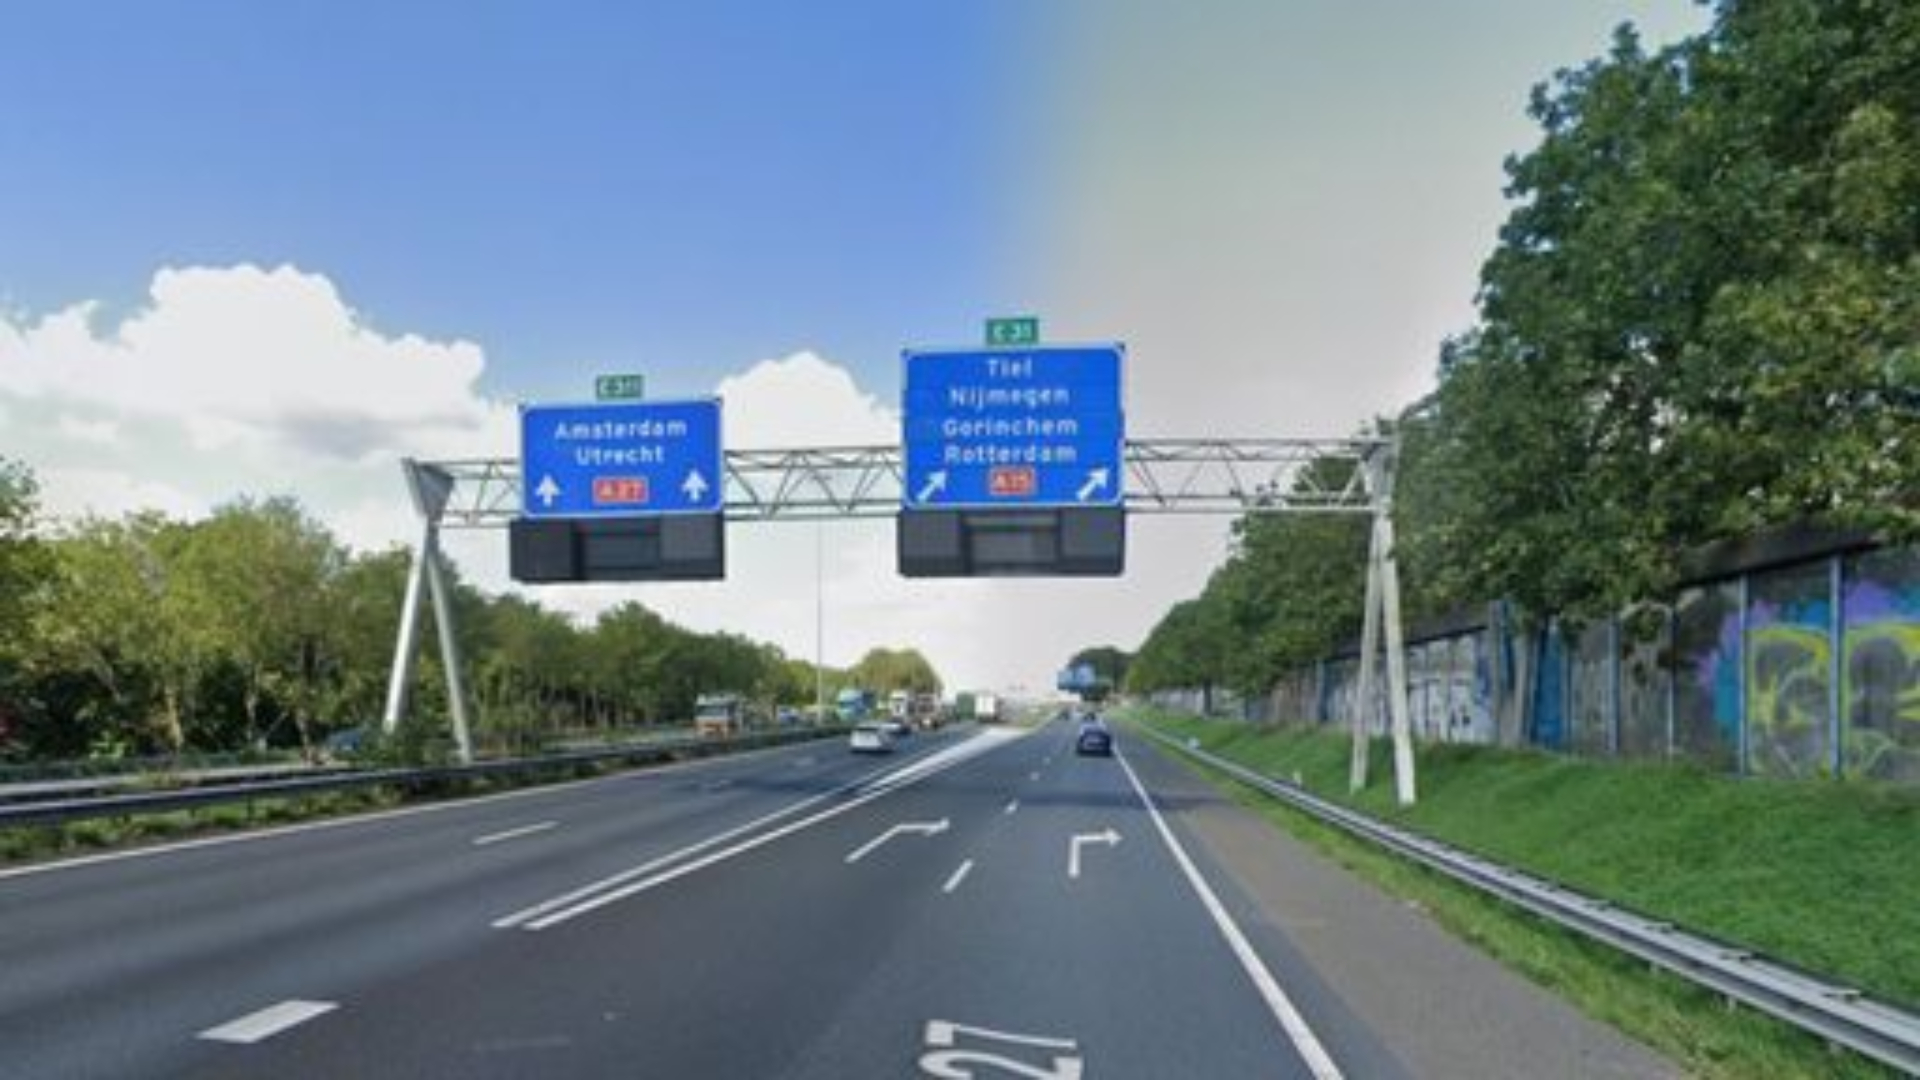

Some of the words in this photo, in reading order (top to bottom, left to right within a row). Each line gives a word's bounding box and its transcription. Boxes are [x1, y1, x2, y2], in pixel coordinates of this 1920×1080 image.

[987, 359, 1033, 377] Tiel
[951, 388, 1070, 410] Nijmegen
[554, 420, 687, 440] Amsterdam
[943, 418, 1078, 436] Gorinchem
[576, 446, 665, 466] Utrecht
[944, 444, 1077, 462] Rotterdam
